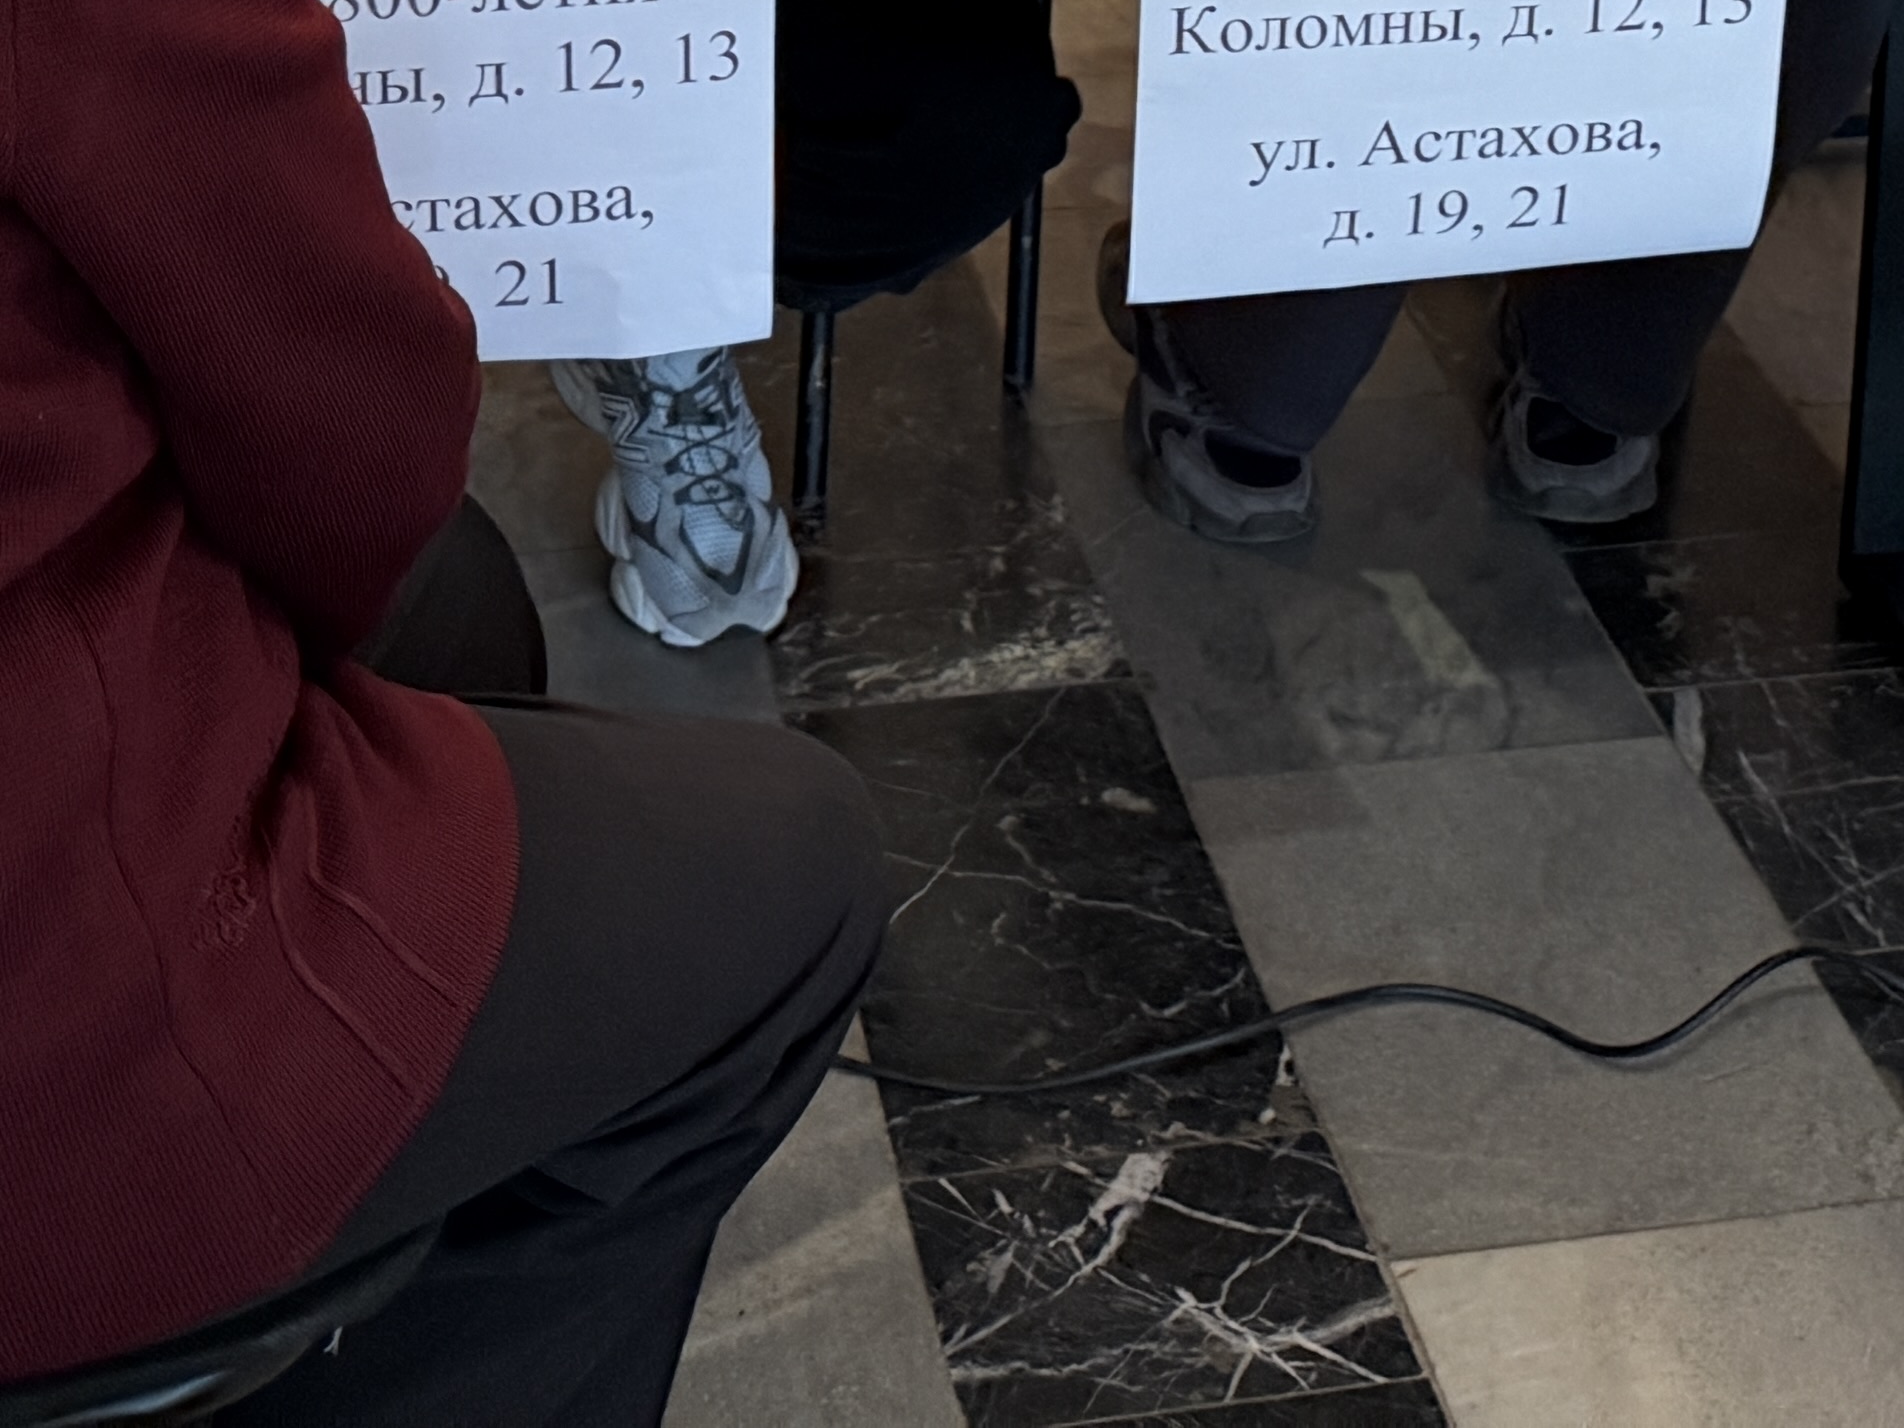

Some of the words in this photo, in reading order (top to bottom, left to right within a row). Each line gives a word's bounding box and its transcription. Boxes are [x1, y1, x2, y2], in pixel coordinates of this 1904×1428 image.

[1169, 5, 1481, 55] Коломны,
[1502, 5, 1554, 46] д.
[468, 63, 525, 107] д.
[558, 39, 645, 99] 12,
[677, 30, 740, 84] 13
[1249, 139, 1336, 187] ул.
[1358, 119, 1661, 168] Астахова,
[391, 186, 654, 233] стахова,
[1323, 210, 1375, 248] д.
[1408, 190, 1484, 240] 19,
[1506, 184, 1568, 229] 21
[495, 258, 564, 307] 21
